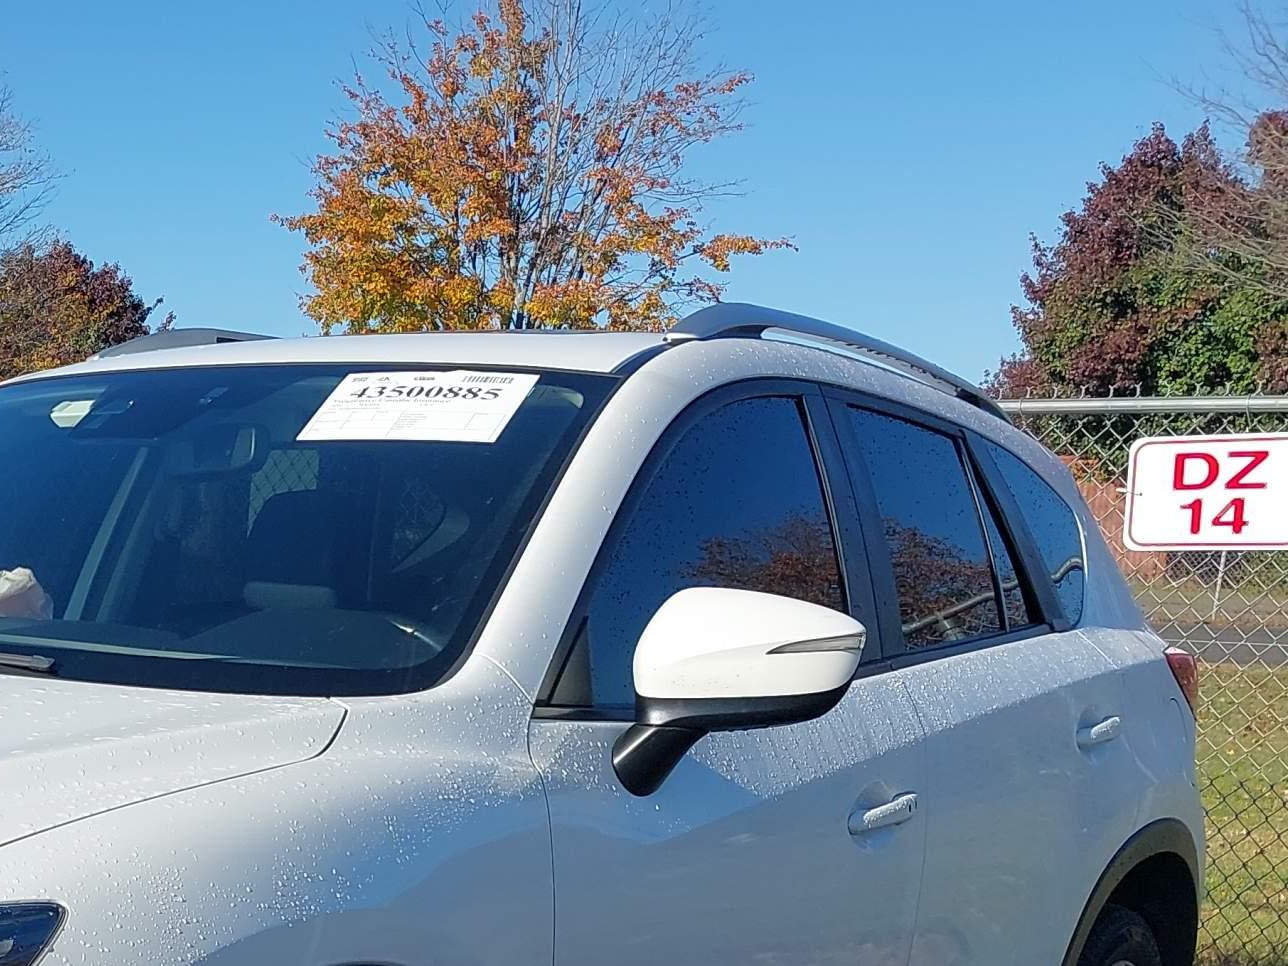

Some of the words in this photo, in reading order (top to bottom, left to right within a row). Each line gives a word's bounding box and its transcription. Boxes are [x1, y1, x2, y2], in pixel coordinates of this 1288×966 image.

[350, 385, 503, 400] 43500885
[1172, 450, 1269, 491] DZ
[1180, 498, 1249, 535] 14
